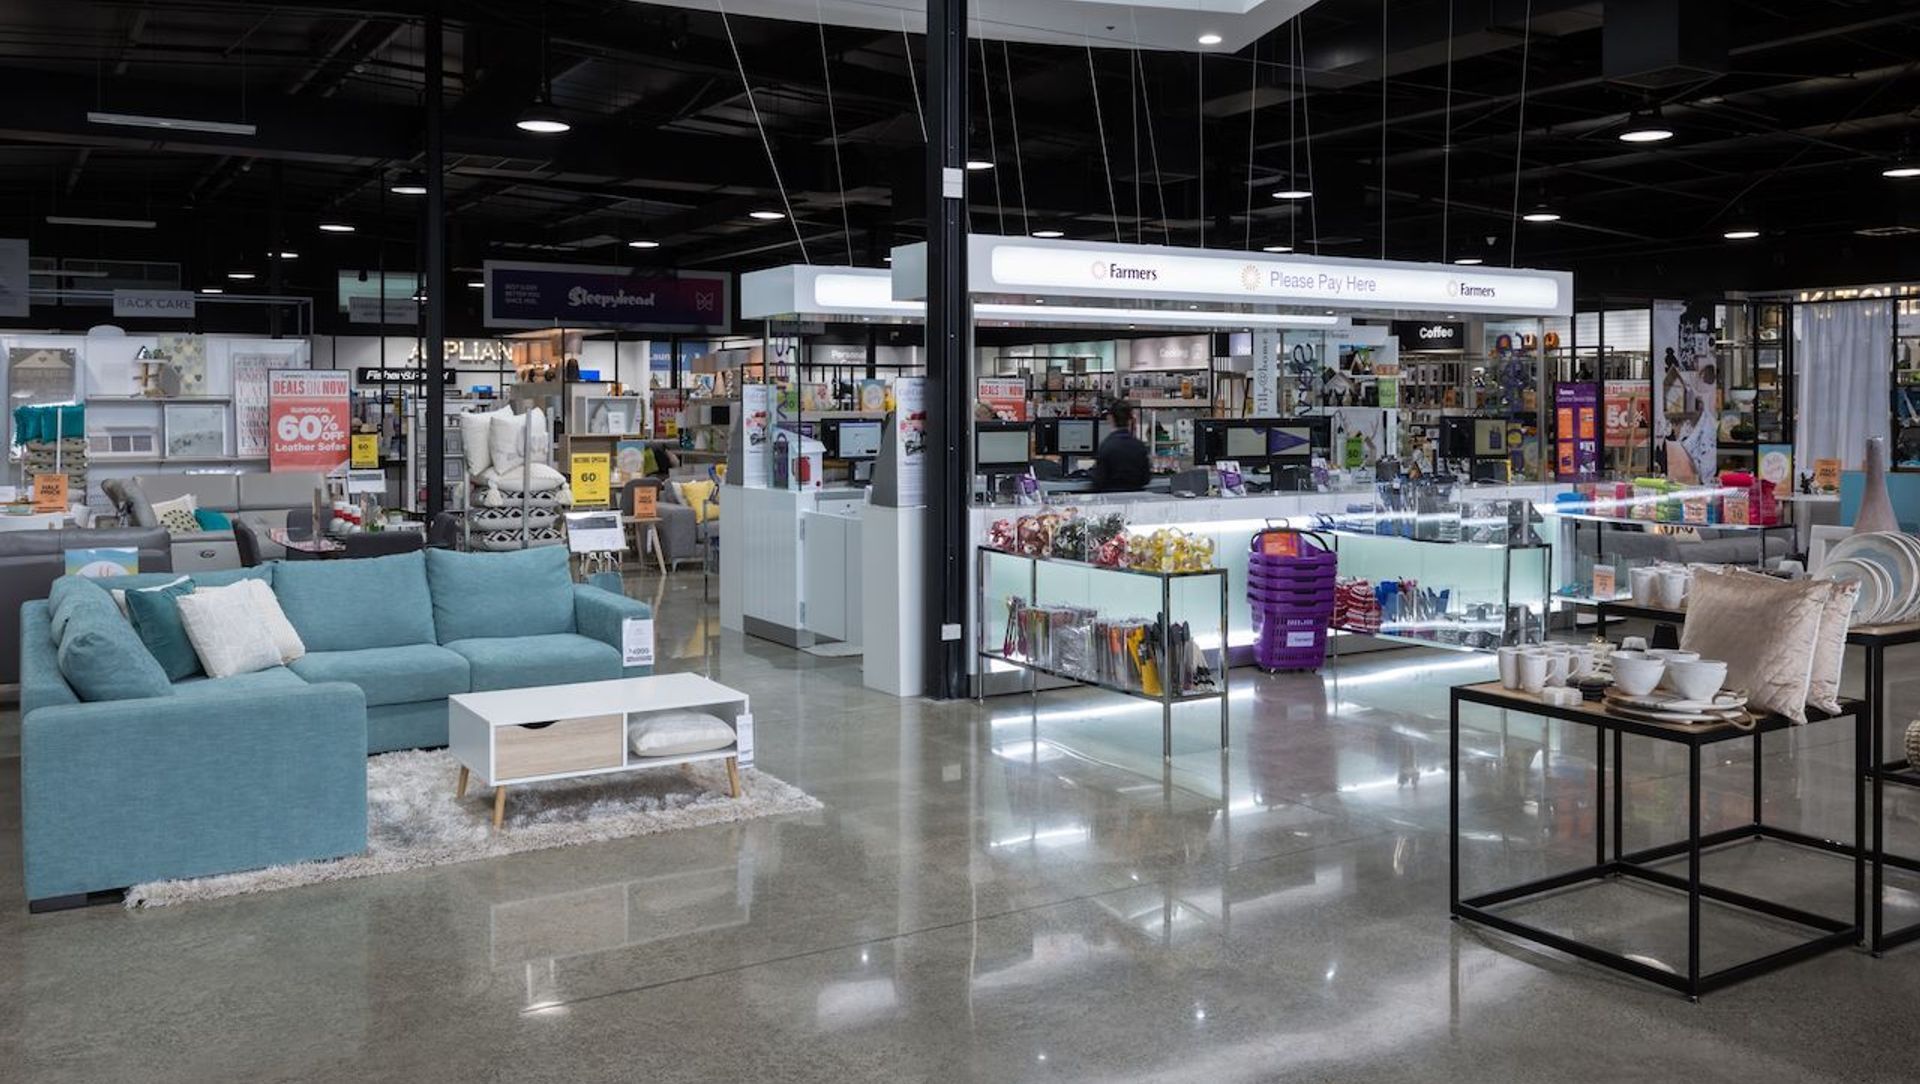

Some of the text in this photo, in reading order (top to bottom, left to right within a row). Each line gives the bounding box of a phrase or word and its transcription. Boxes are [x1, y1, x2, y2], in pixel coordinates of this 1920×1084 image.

[1110, 263, 1158, 281] Farmers
[1270, 271, 1377, 294] Please Pay Here
[1460, 282, 1495, 298] Farmers
[156, 299, 192, 310] CARE
[568, 286, 655, 308] Sleepyhead
[1419, 325, 1454, 339] Coffee
[408, 341, 514, 362] APLIAN
[1257, 338, 1273, 415] Tilly@home
[273, 379, 305, 395] DEALS
[322, 380, 347, 395] NOW
[277, 414, 339, 441] 60%
[321, 431, 345, 441] OFF
[275, 441, 347, 452] Leather Sofas
[580, 472, 597, 482] 60
